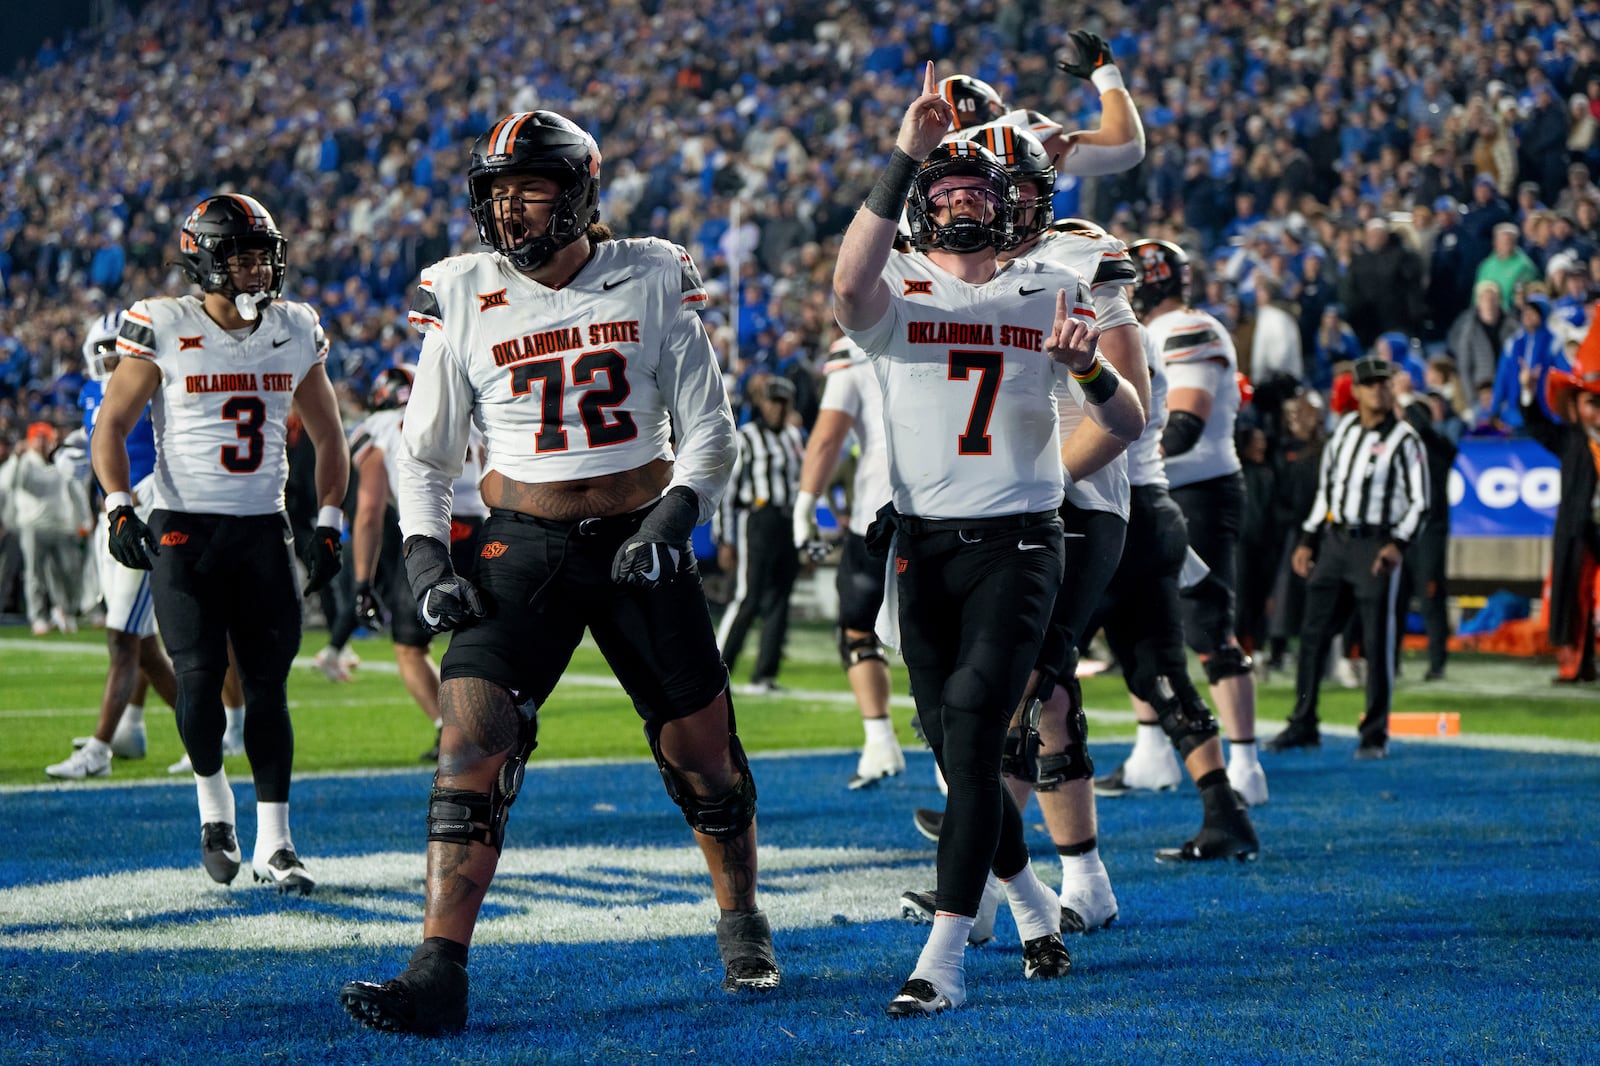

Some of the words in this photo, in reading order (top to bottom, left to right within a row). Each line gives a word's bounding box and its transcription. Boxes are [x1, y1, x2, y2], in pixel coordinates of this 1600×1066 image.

[957, 98, 976, 112] 40
[478, 288, 509, 312] XII
[904, 280, 933, 295] XII
[492, 327, 583, 366] OKLAHOMA
[588, 320, 640, 346] STATE
[907, 321, 994, 346] OKLAHOMA
[999, 325, 1044, 352] STATE
[185, 374, 258, 393] OKLAHOMA
[262, 373, 293, 392] STATE
[510, 348, 638, 453] 72
[947, 349, 1004, 456] 7
[220, 396, 266, 473] 3
